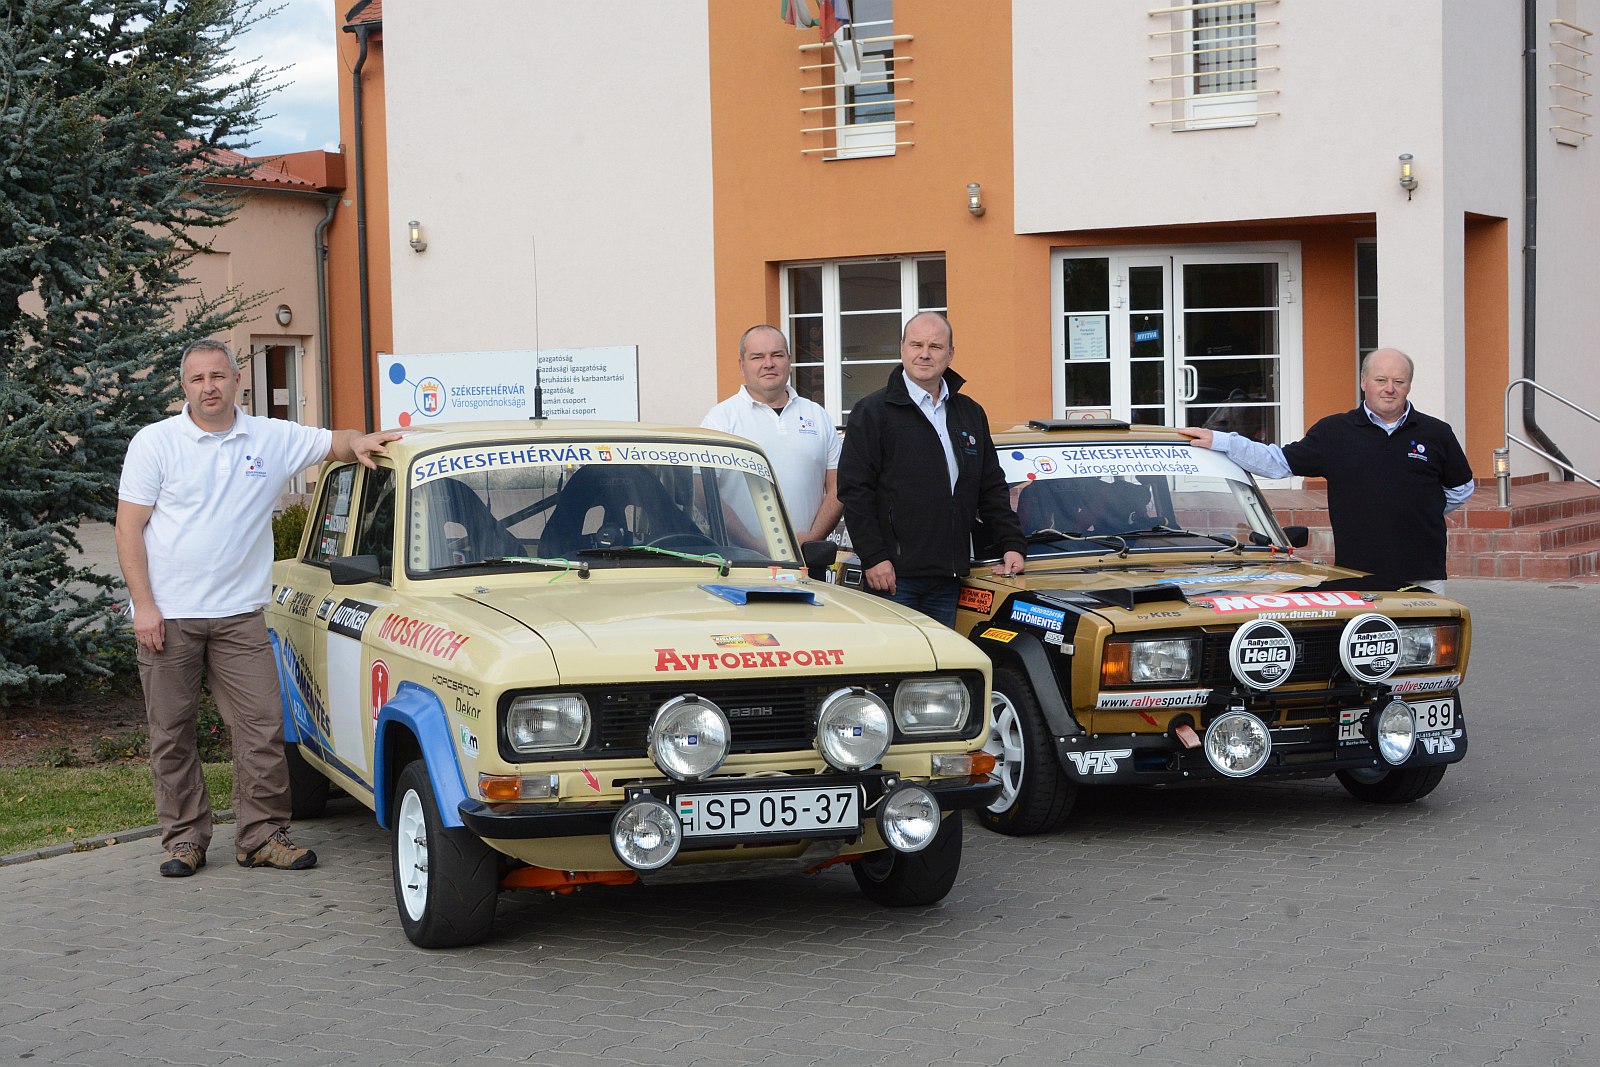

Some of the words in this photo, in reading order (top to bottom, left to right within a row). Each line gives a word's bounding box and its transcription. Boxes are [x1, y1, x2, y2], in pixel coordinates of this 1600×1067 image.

[1137, 332, 1157, 340] NYITVA
[537, 355, 573, 363] gazgatóság
[569, 365, 607, 373] igazgatóság
[582, 374, 624, 382] karbantartási
[451, 383, 525, 396] SZÉKESFEHÉRVÁR
[451, 396, 526, 409] Városgondnoksága
[543, 397, 560, 405] umán
[562, 397, 587, 405] csoport
[542, 407, 571, 416] ogisztikai
[572, 408, 597, 416] csoport
[1061, 445, 1192, 461] SZÉKESFEHÉRVÁR
[414, 444, 593, 482] SZÉKESFEHÉRVÁR
[616, 446, 771, 477] Városgondnoksága
[1067, 461, 1199, 475] Városgondnoksága
[1212, 593, 1365, 611] MOTUL
[331, 604, 370, 632] AUTÓKER
[1011, 610, 1062, 631] AUTÓMENTÉS
[1257, 609, 1337, 620] www.duen.hu
[378, 613, 470, 660] MOSKVICH
[1244, 648, 1287, 663] Hella
[1354, 641, 1395, 657] Hella
[655, 648, 845, 672] AVTOEXPORT
[1372, 660, 1391, 668] HELLA
[455, 696, 482, 719] Dekor
[1101, 693, 1210, 708] www.rallyesport.hu
[705, 798, 751, 830] SP
[759, 793, 853, 828] 05-37
[681, 817, 694, 832] H
